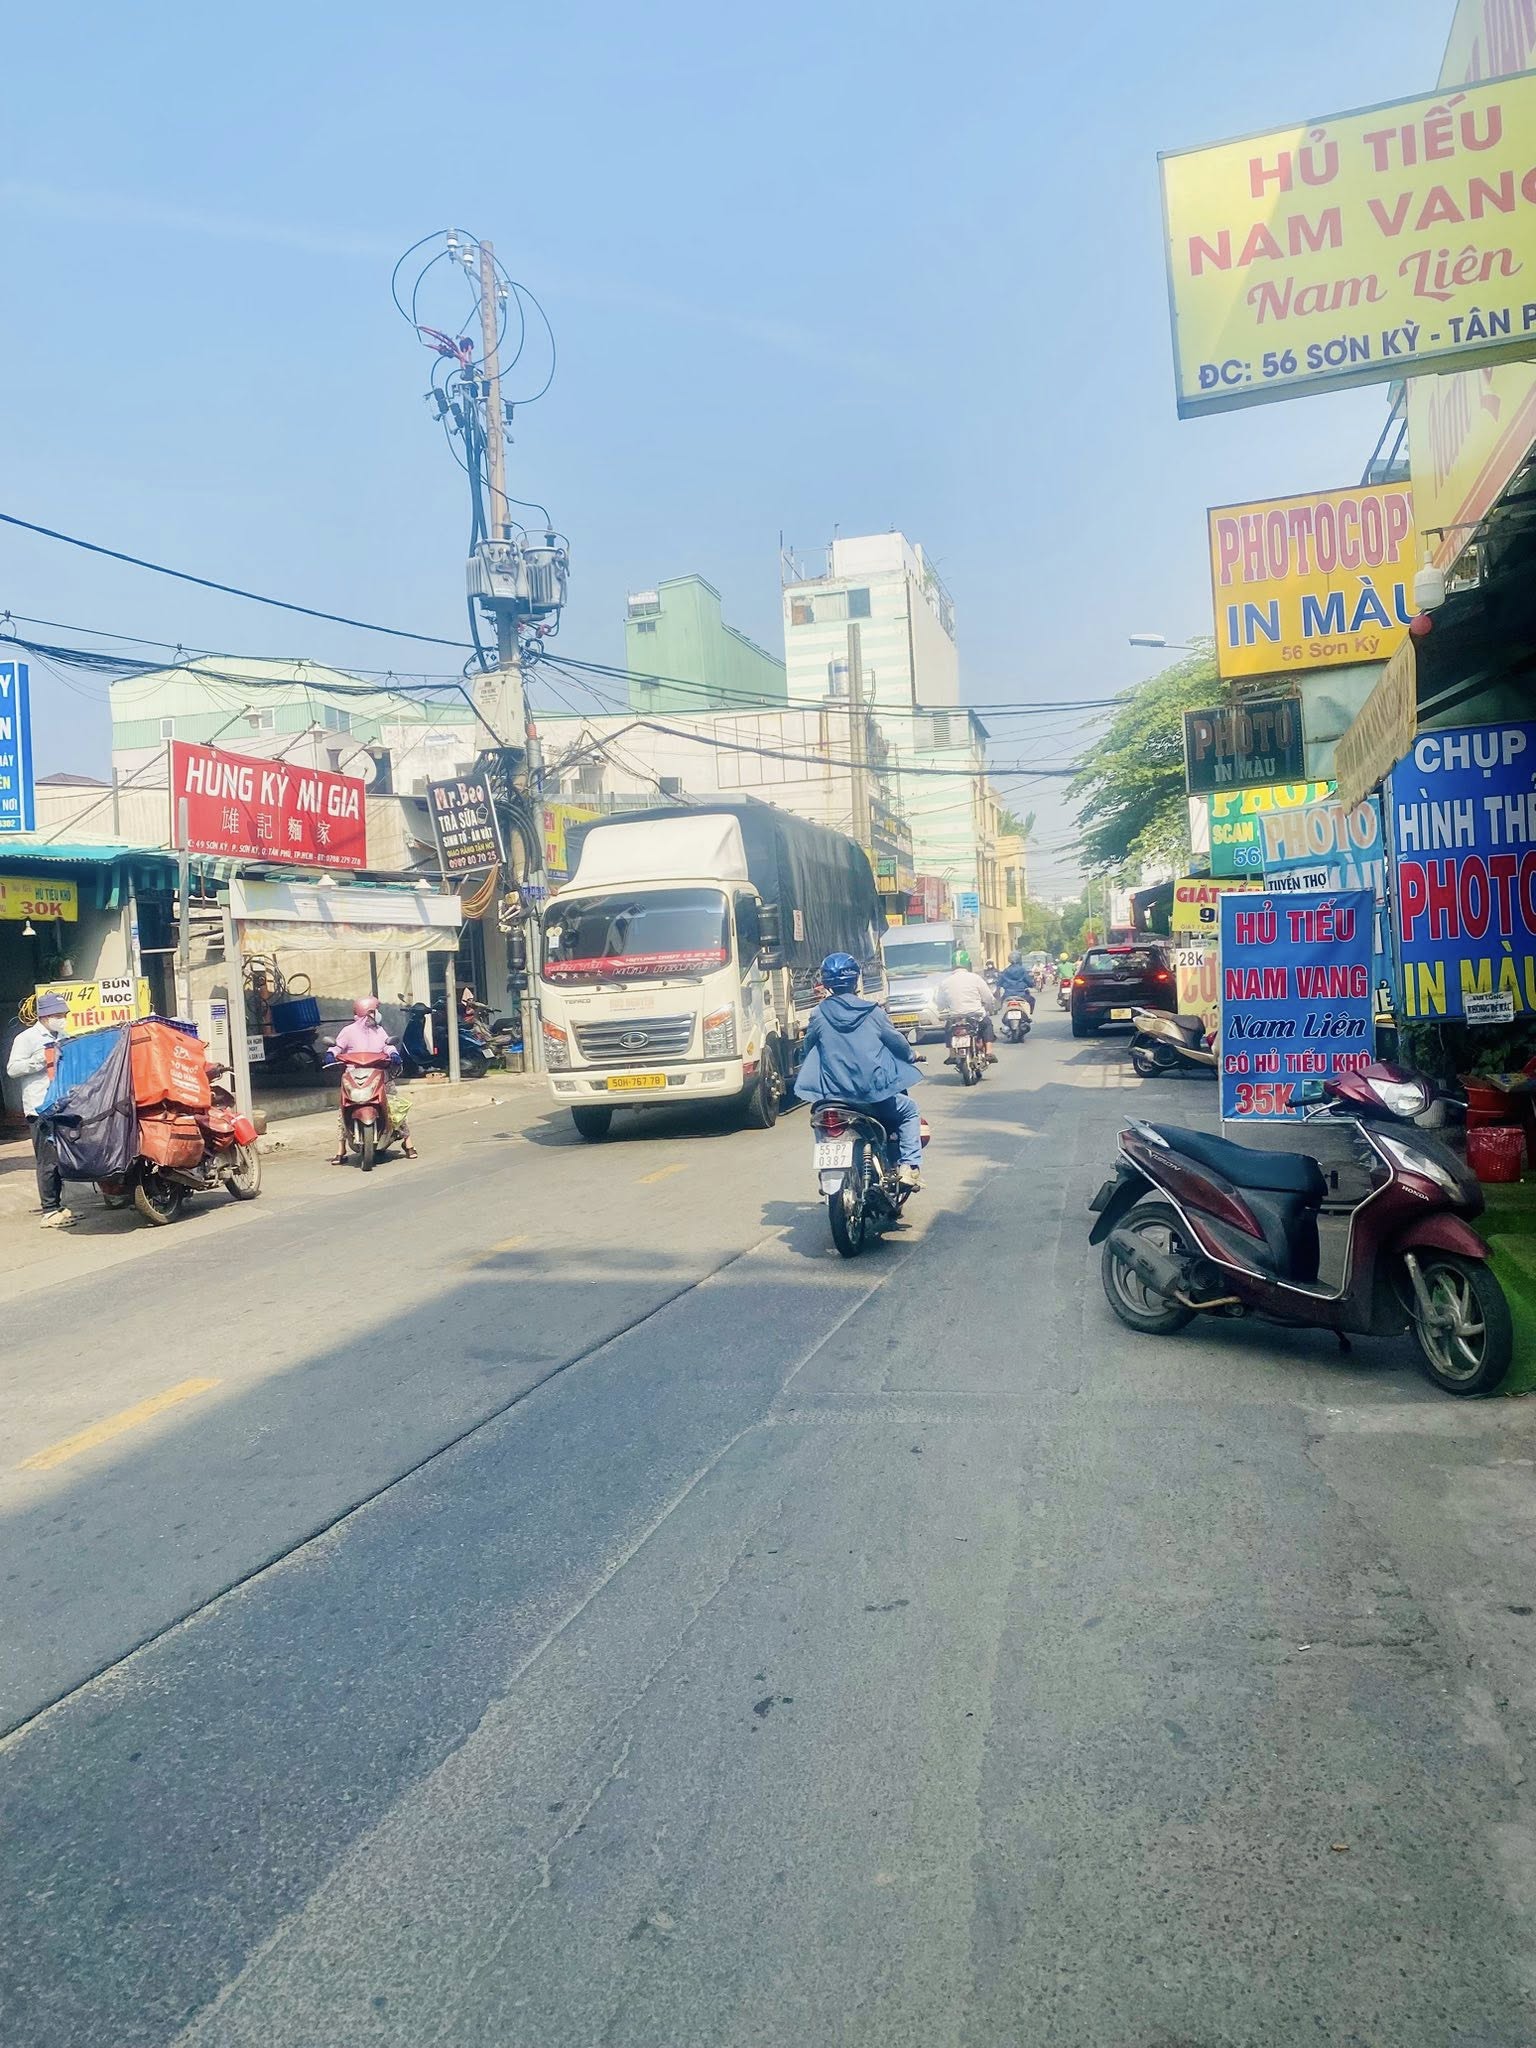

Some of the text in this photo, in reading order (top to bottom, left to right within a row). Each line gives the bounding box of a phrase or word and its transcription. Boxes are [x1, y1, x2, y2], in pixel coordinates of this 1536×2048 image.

[1249, 93, 1503, 198] HỦ TIẾU
[1188, 207, 1344, 276] NAM
[1246, 244, 1523, 325] Nam Liên
[1199, 359, 1252, 389] ĐC:
[1262, 349, 1298, 378] 56
[1307, 334, 1370, 370] SƠN
[1382, 319, 1421, 356] KỲ
[1448, 306, 1511, 343] TÂN
[1216, 491, 1415, 587] PHOTOCOP
[1226, 600, 1281, 648] IN
[1282, 635, 1381, 662] 56 Sơn Kỳ
[1193, 706, 1293, 761] PHOTO
[1414, 730, 1527, 778] CHỤP
[1214, 756, 1276, 782] IN MÀU
[185, 750, 254, 802] HÙNG
[296, 772, 323, 814] MÌ
[327, 784, 360, 821] GIA
[438, 807, 479, 833] TRÀ SỮA
[1212, 821, 1254, 845] SCAN
[1398, 788, 1476, 852] HÌNH
[1233, 847, 1261, 867] 56
[1303, 872, 1327, 889] THỢ
[20, 901, 63, 915] 30K
[1236, 900, 1356, 945] HỦ TIẾU
[78, 987, 95, 1001] 47
[102, 979, 130, 989] BÚN
[1225, 968, 1290, 1001] NAM
[1296, 965, 1368, 999] VANG
[1404, 961, 1447, 1017] IN
[102, 993, 132, 1004] MỌC
[72, 1006, 131, 1026] TIẾU MÌ
[1228, 1012, 1366, 1040] Nam Liên
[1224, 1048, 1372, 1074] CÓ HỦ TIẾU KHÔ
[1235, 1083, 1296, 1114] 35K
[819, 1155, 846, 1166] 0387
[820, 1144, 846, 1155] 55-P7
[1401, 1185, 1430, 1201] HONDA
